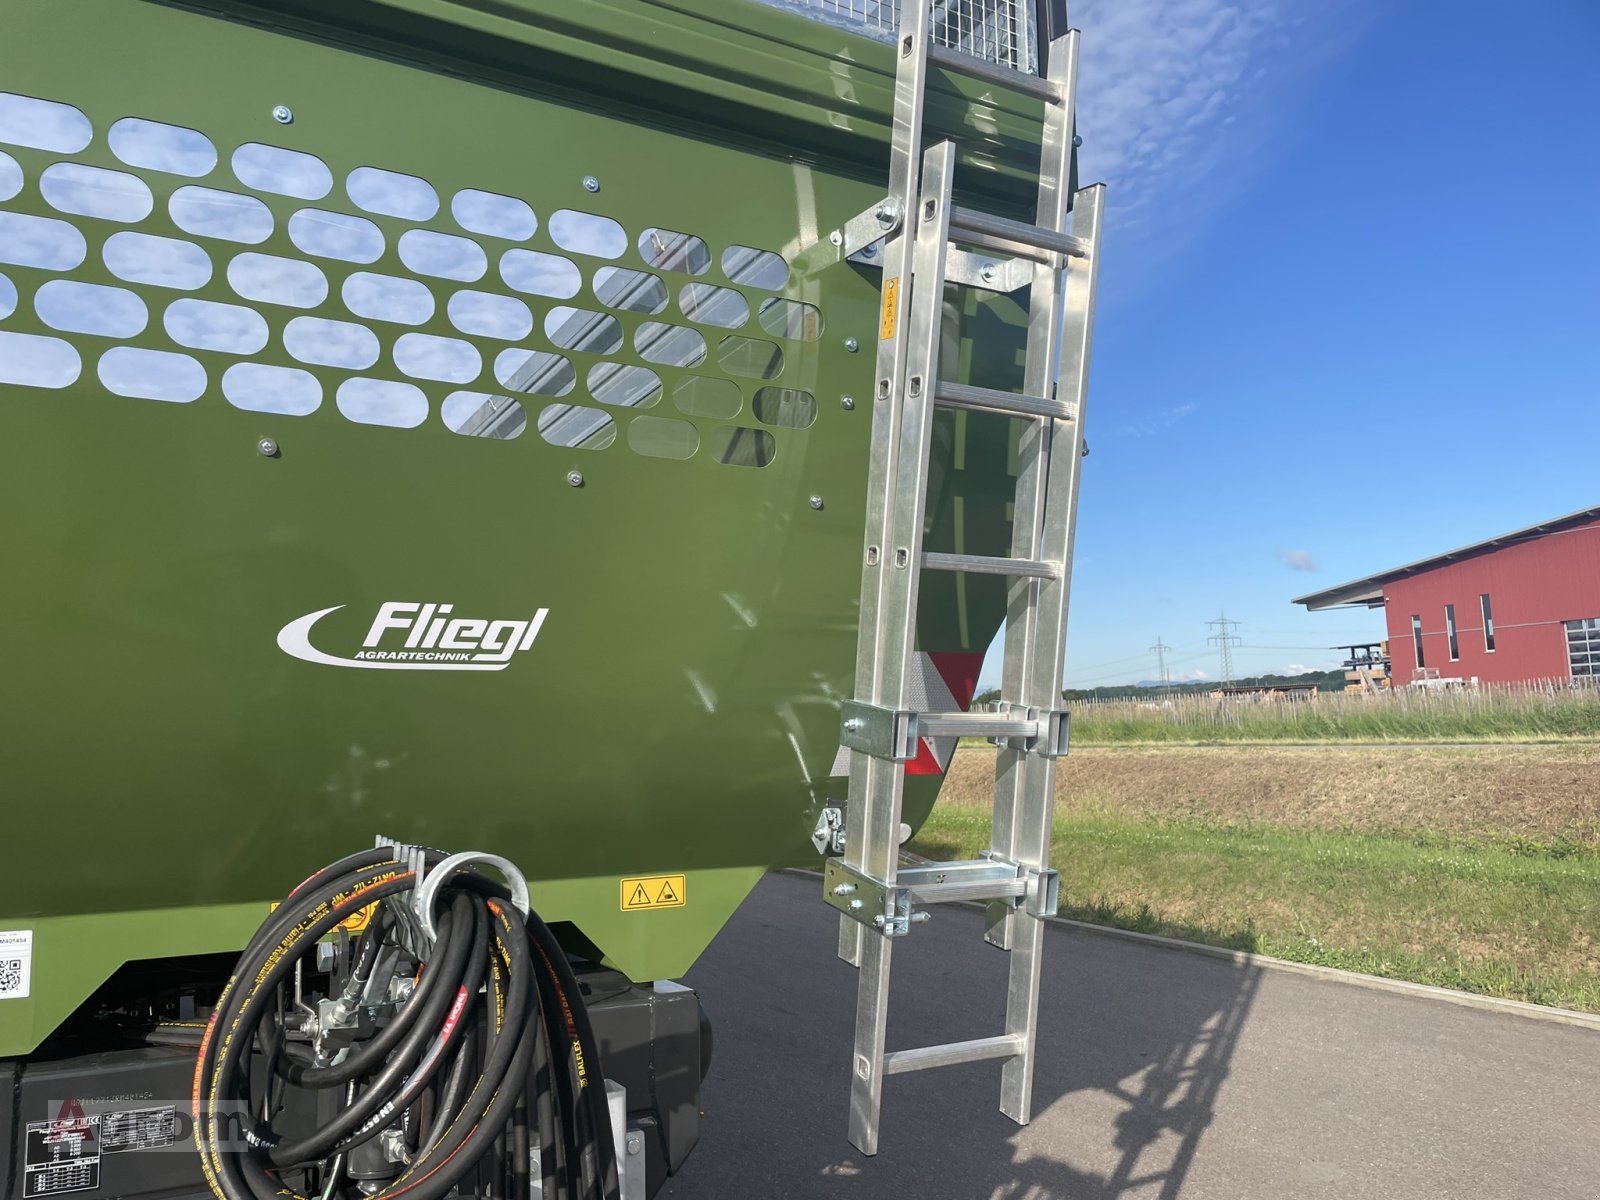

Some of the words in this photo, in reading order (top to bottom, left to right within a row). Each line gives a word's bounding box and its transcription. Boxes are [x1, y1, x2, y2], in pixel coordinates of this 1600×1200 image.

[362, 601, 550, 662] Fliegl
[353, 650, 470, 662] AGRARTECHNIK
[281, 923, 304, 946] Flame
[450, 992, 467, 1021] ValCon
[573, 1040, 586, 1077] BALFLEX
[376, 1100, 395, 1120] EN
